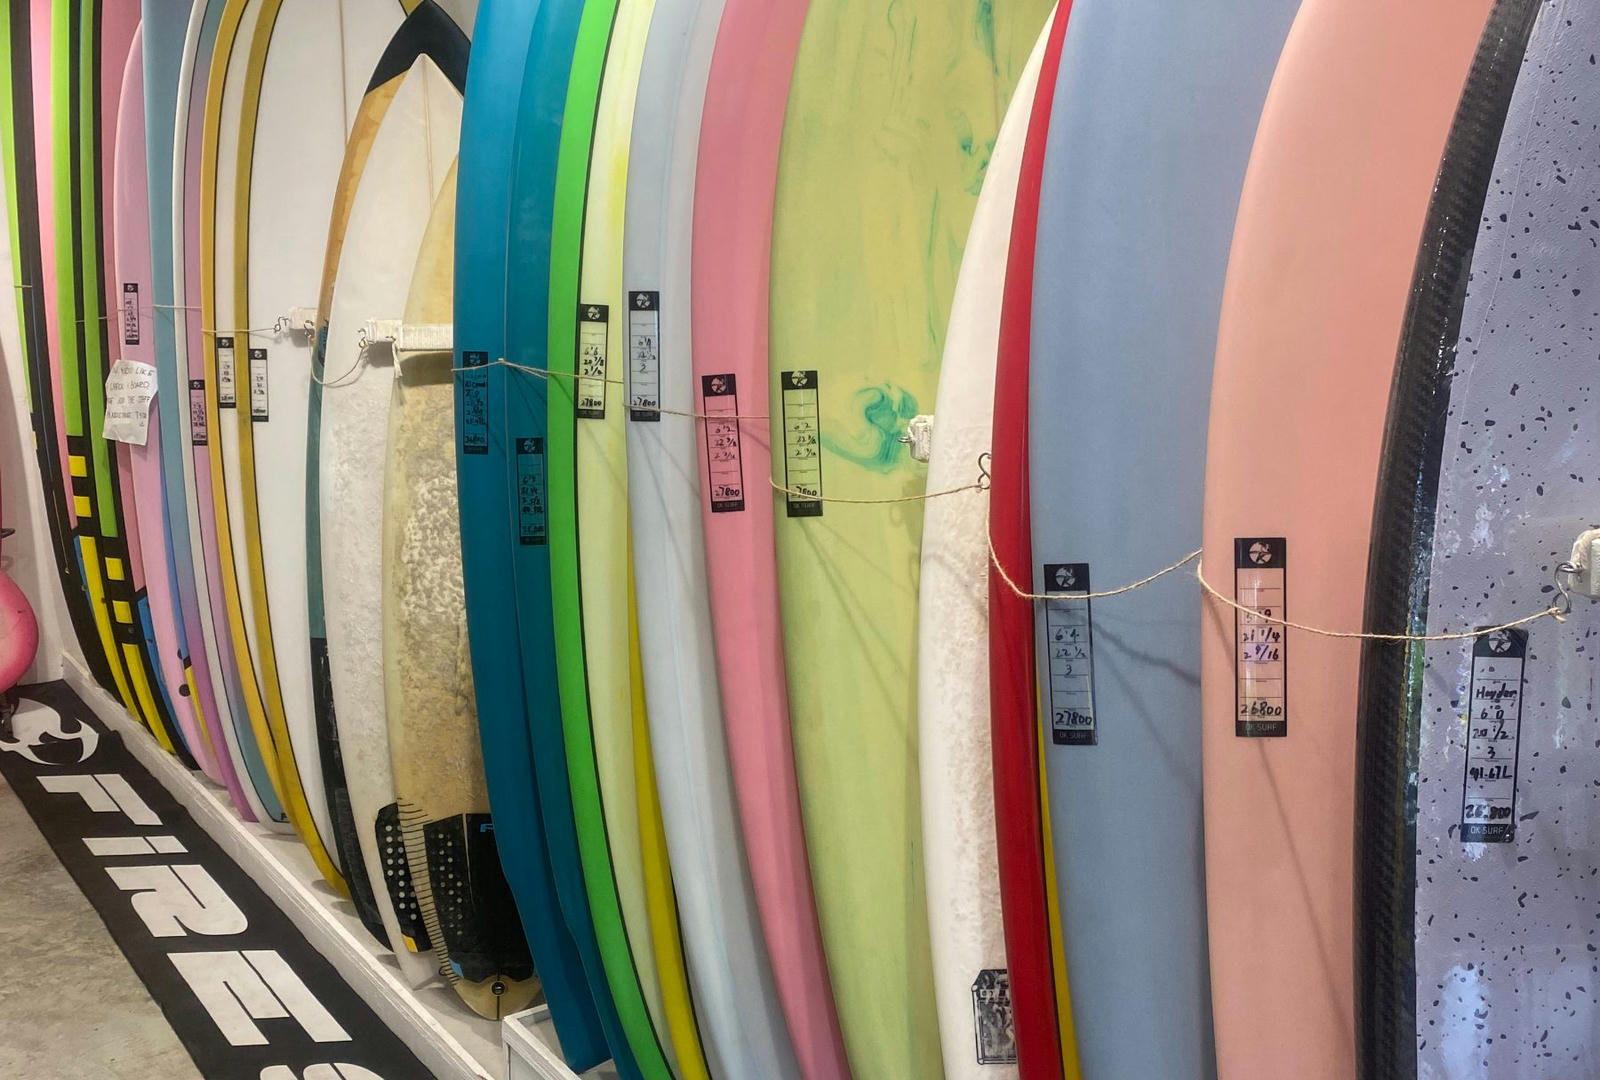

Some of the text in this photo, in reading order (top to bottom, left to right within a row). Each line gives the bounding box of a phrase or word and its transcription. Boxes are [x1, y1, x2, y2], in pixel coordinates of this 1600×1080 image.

[1240, 701, 1282, 716] 26800
[1055, 710, 1092, 726] 27800
[1470, 826, 1504, 835] OK SURF
